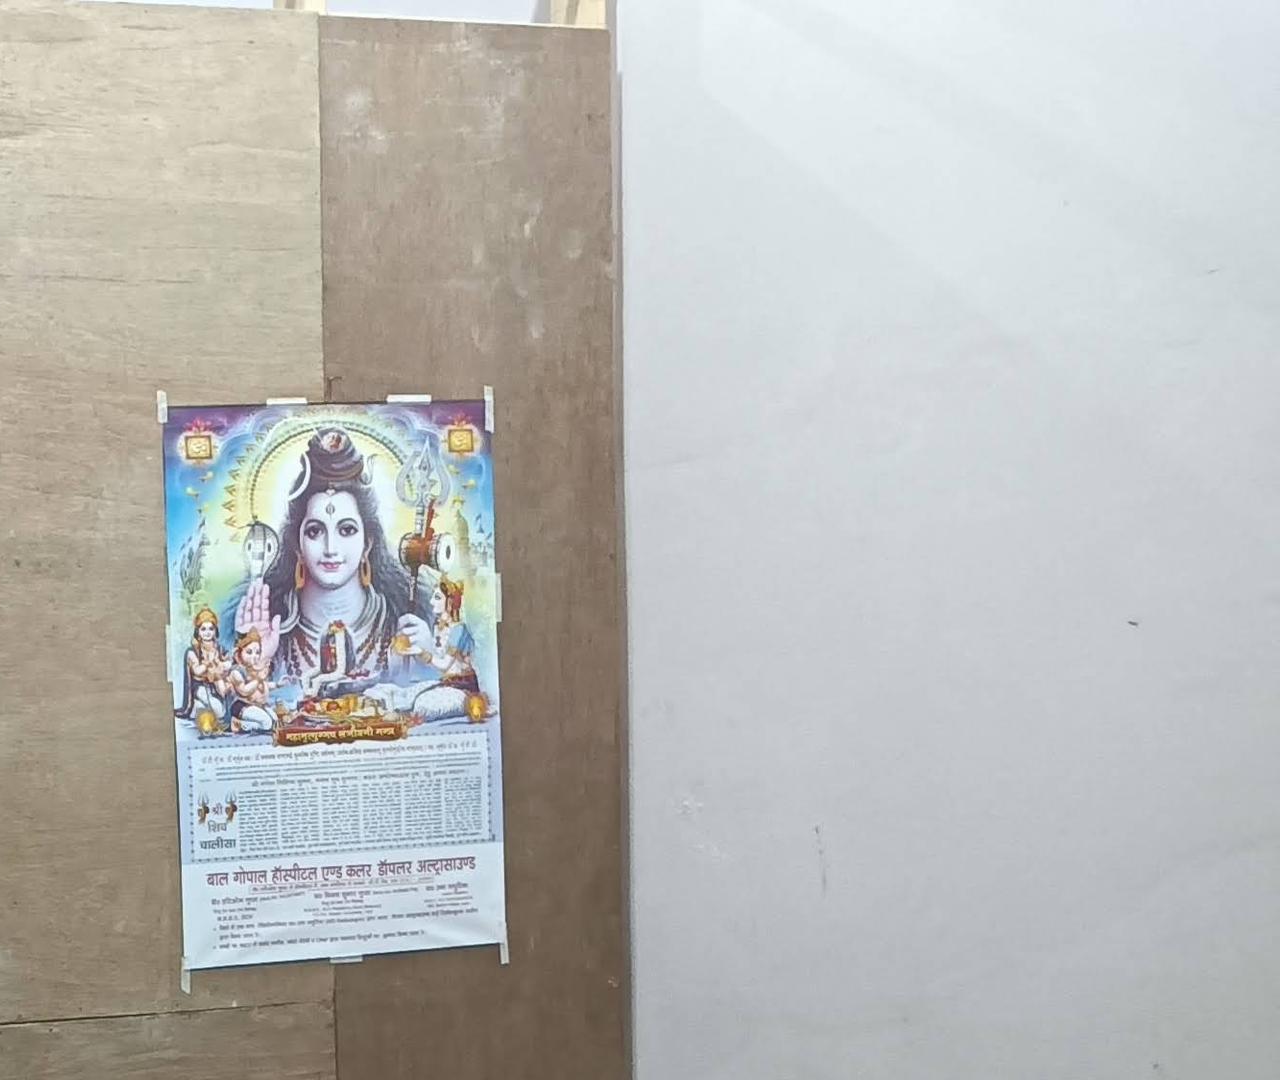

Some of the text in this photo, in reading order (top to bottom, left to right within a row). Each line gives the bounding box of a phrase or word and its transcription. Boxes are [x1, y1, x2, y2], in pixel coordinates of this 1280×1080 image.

[211, 802, 223, 815] श्री
[207, 820, 227, 833] शिव
[200, 837, 236, 850] चालीसा
[206, 872, 229, 886] बाल
[233, 866, 267, 884] गोपाल
[271, 862, 317, 885] हॉस्पीटल
[322, 866, 343, 881] एण्ड
[346, 864, 371, 878] कलर
[377, 859, 412, 876] डॉपलर
[417, 856, 476, 875] अल्ट्रासाउण्ड
